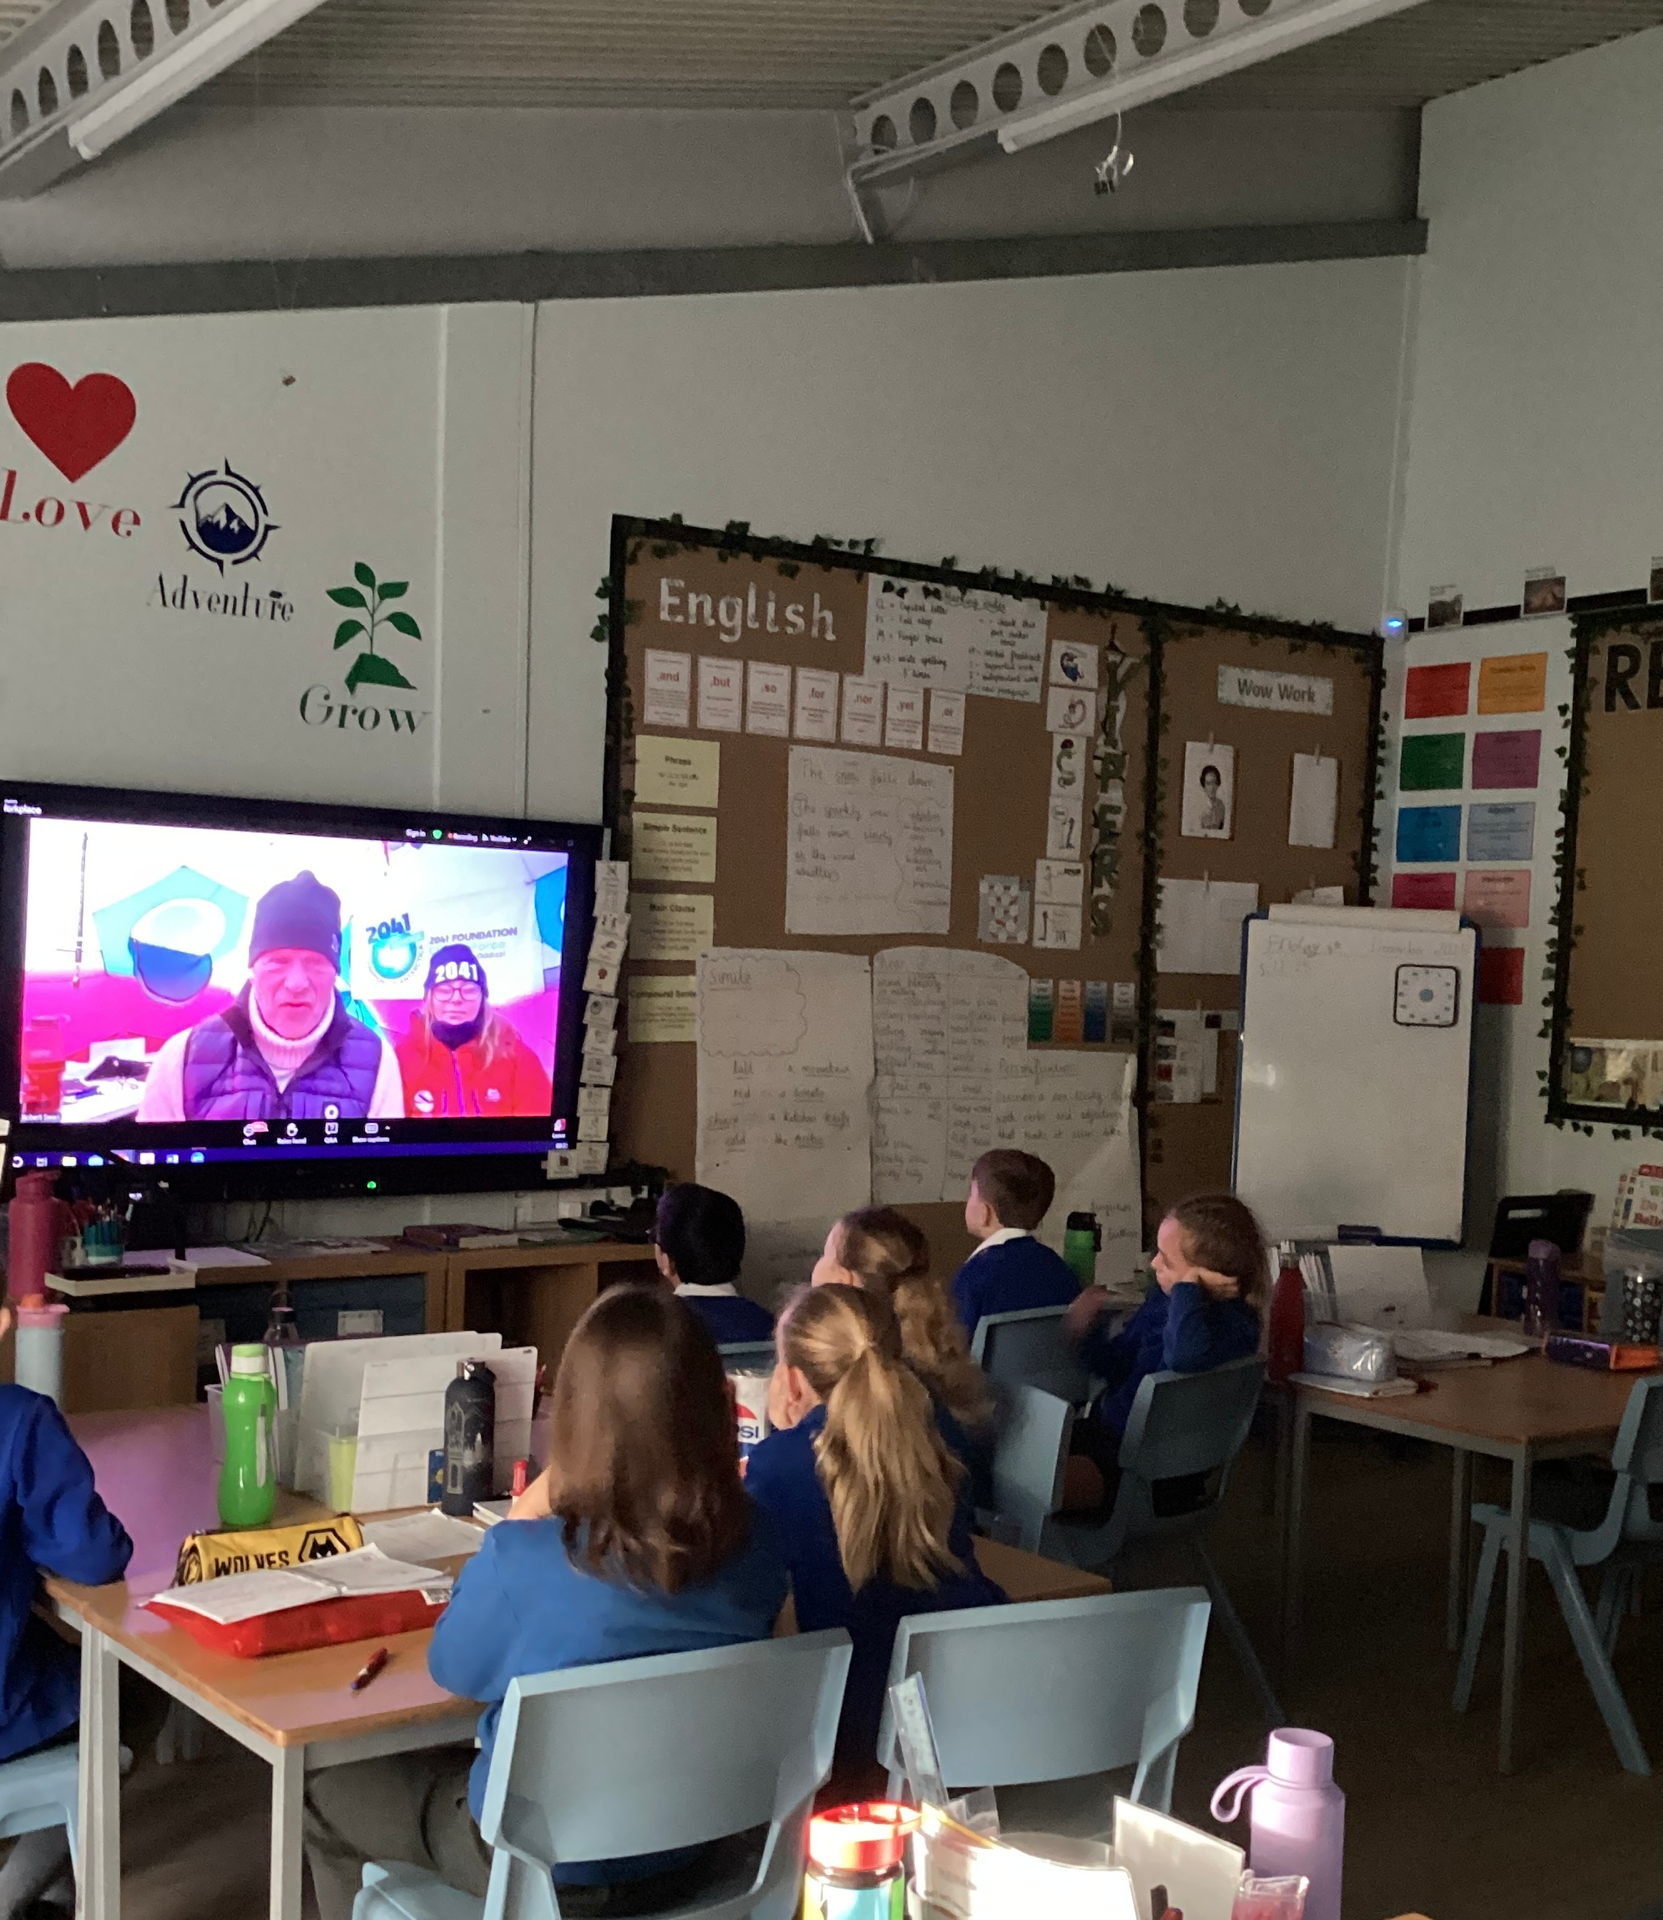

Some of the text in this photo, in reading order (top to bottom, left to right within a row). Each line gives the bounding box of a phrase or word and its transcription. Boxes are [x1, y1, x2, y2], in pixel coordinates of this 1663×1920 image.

[0, 468, 141, 538] Love
[660, 578, 836, 642] English
[1237, 678, 1316, 702] Wow Work
[300, 684, 431, 735] Grow
[366, 912, 411, 944] 2041
[452, 927, 518, 943] FOUNDATION
[435, 961, 479, 984] 2041
[737, 1425, 759, 1439] SI
